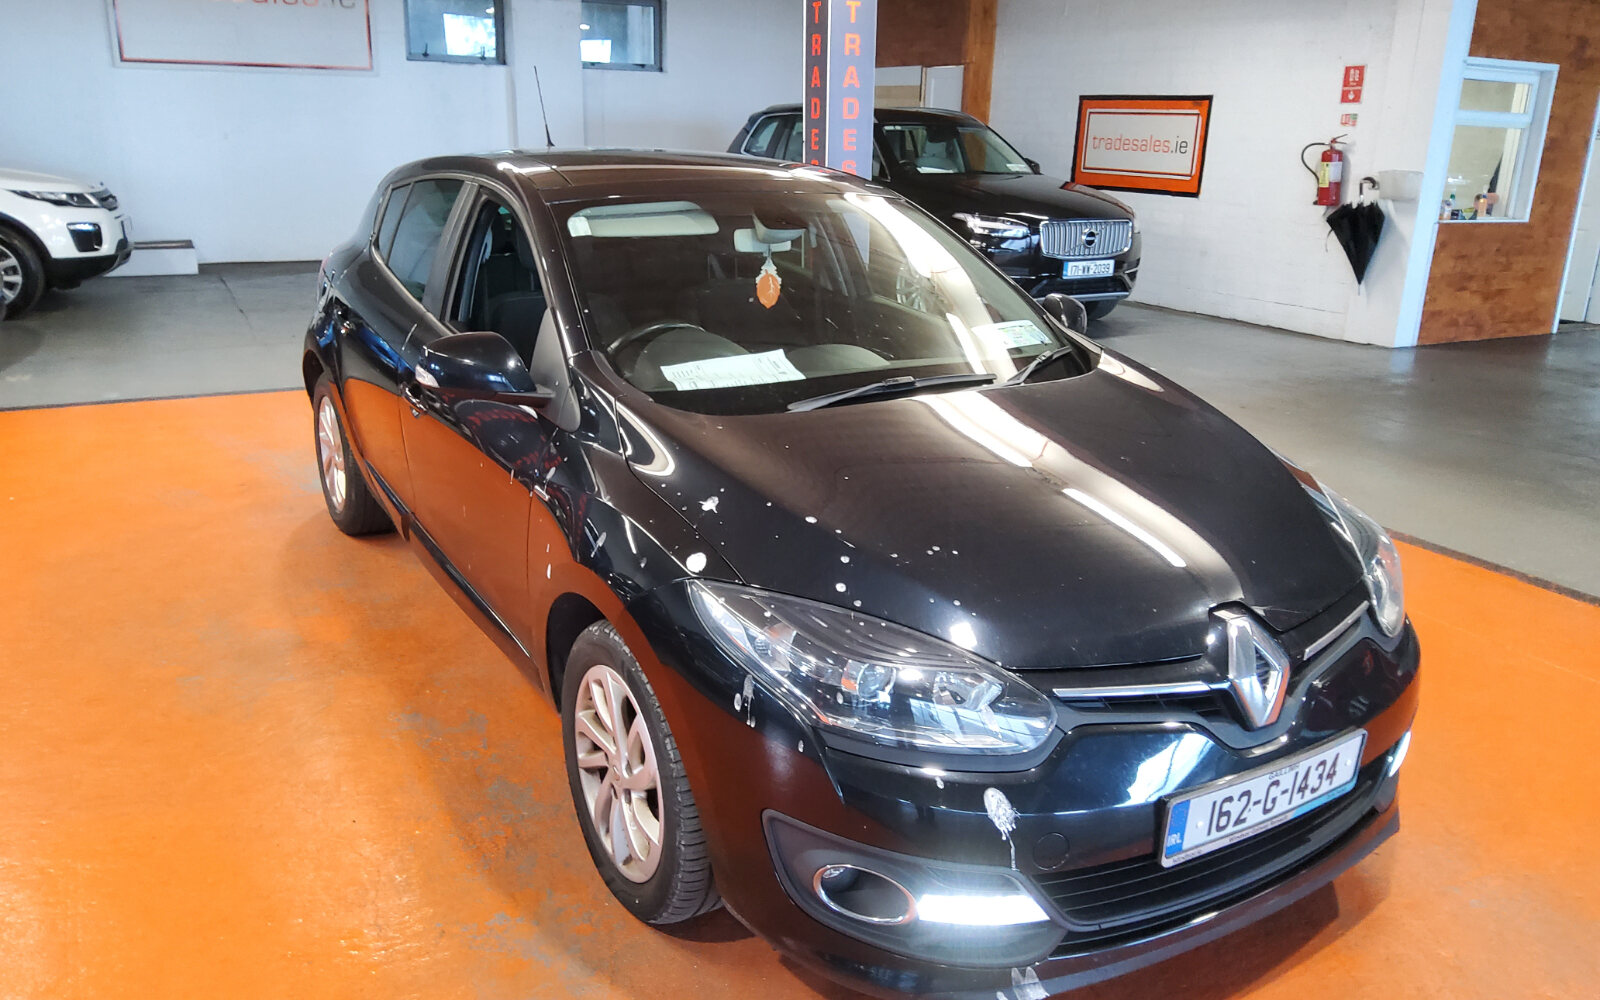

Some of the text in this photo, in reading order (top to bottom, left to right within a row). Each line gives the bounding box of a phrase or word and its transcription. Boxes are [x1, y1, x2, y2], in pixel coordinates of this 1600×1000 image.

[811, 1, 822, 166] TRADE
[1092, 133, 1188, 154] tradesales.ie
[1207, 752, 1340, 837] 162-G-1434
